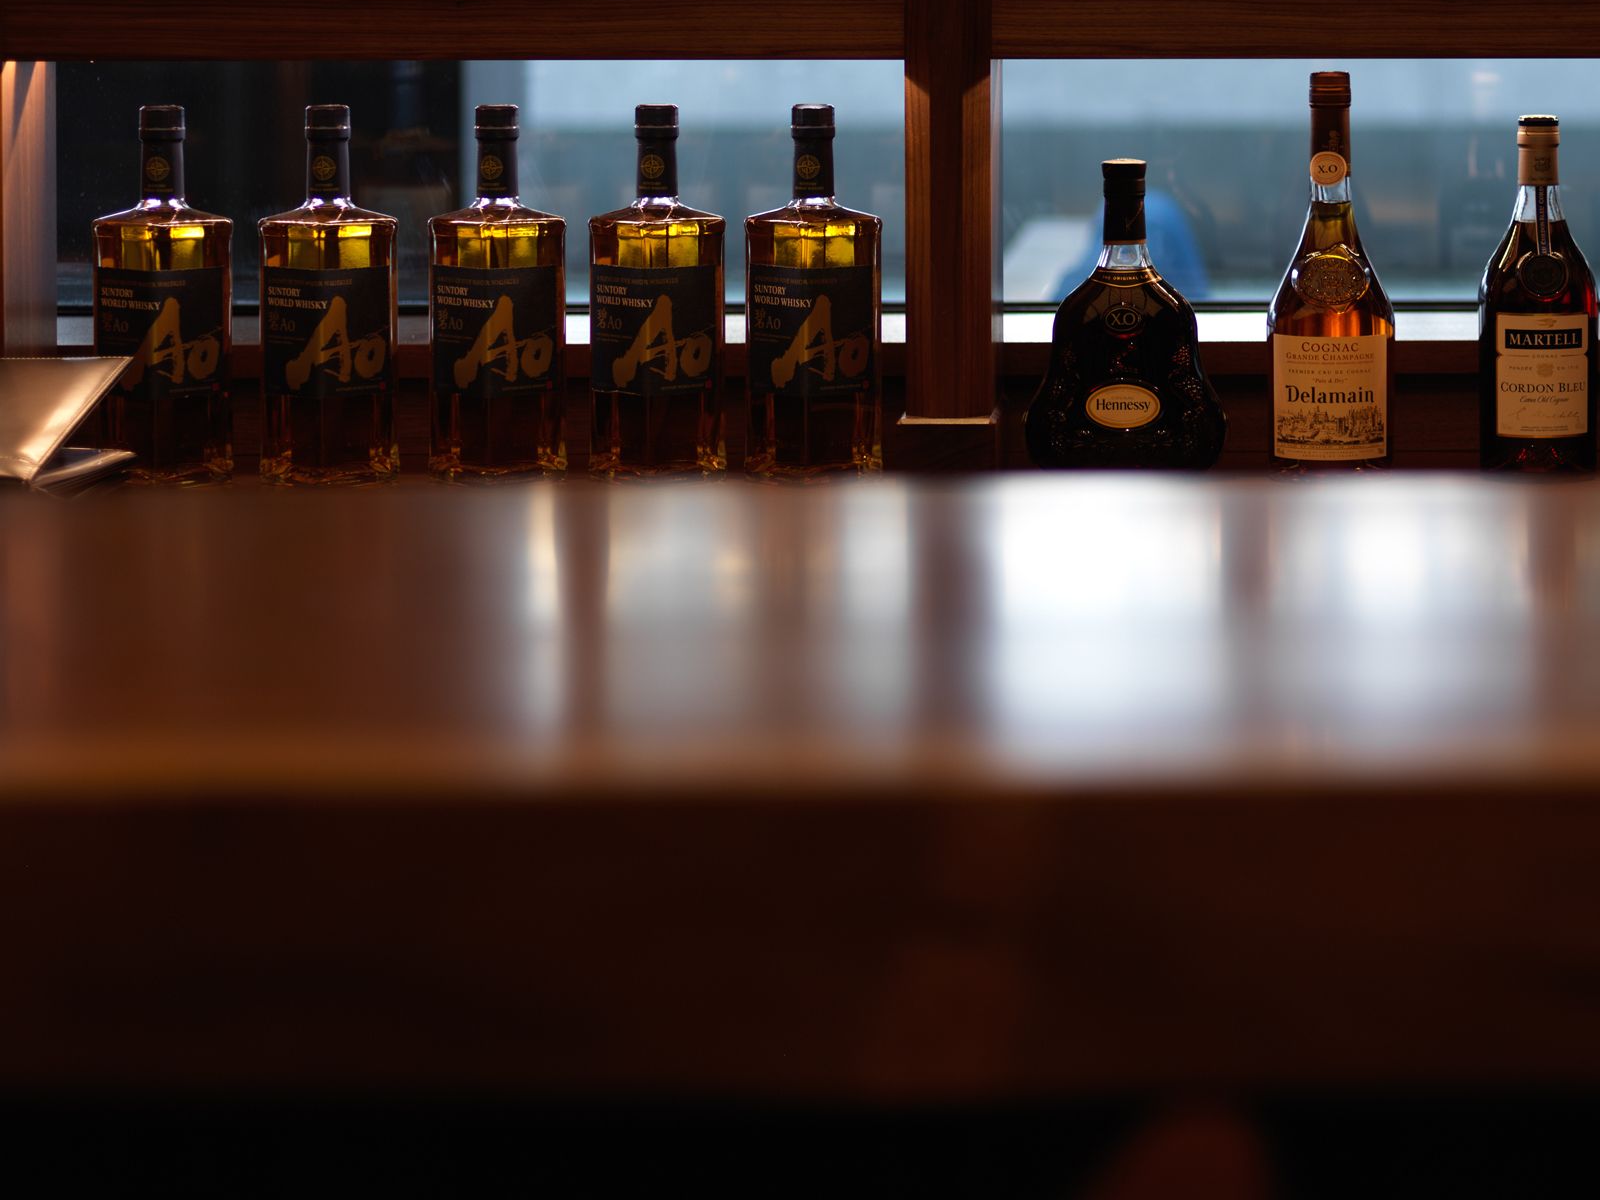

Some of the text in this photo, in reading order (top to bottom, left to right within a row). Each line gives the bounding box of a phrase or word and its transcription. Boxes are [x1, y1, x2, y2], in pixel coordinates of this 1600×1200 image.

[1318, 163, 1338, 174] X.O
[101, 287, 134, 299] SUNTORY
[268, 286, 302, 298] SUNTORY
[437, 285, 469, 297] SUNTORY
[596, 285, 628, 296] SUNTORY
[754, 284, 786, 296] SUNTORY
[101, 298, 161, 312] WORLD WHISKY
[268, 297, 328, 312] WORLD WHISKY
[437, 296, 495, 310] WORLD WHISKY
[596, 295, 655, 309] WORLD WHISKY
[754, 295, 813, 309] WORLD WHISKY
[120, 296, 221, 392] Ao
[285, 295, 386, 392] Ao
[453, 294, 554, 390] Ao
[612, 293, 713, 389] Ao
[770, 293, 871, 390] Ao
[1509, 333, 1580, 346] MARTELL
[1301, 341, 1360, 353] COGNAC
[1286, 351, 1375, 361] GRANDE CHAMPAGNE
[1285, 384, 1375, 404] Delamain
[1500, 380, 1586, 394] CORDON BLEU
[1095, 399, 1151, 414] Hennessy
